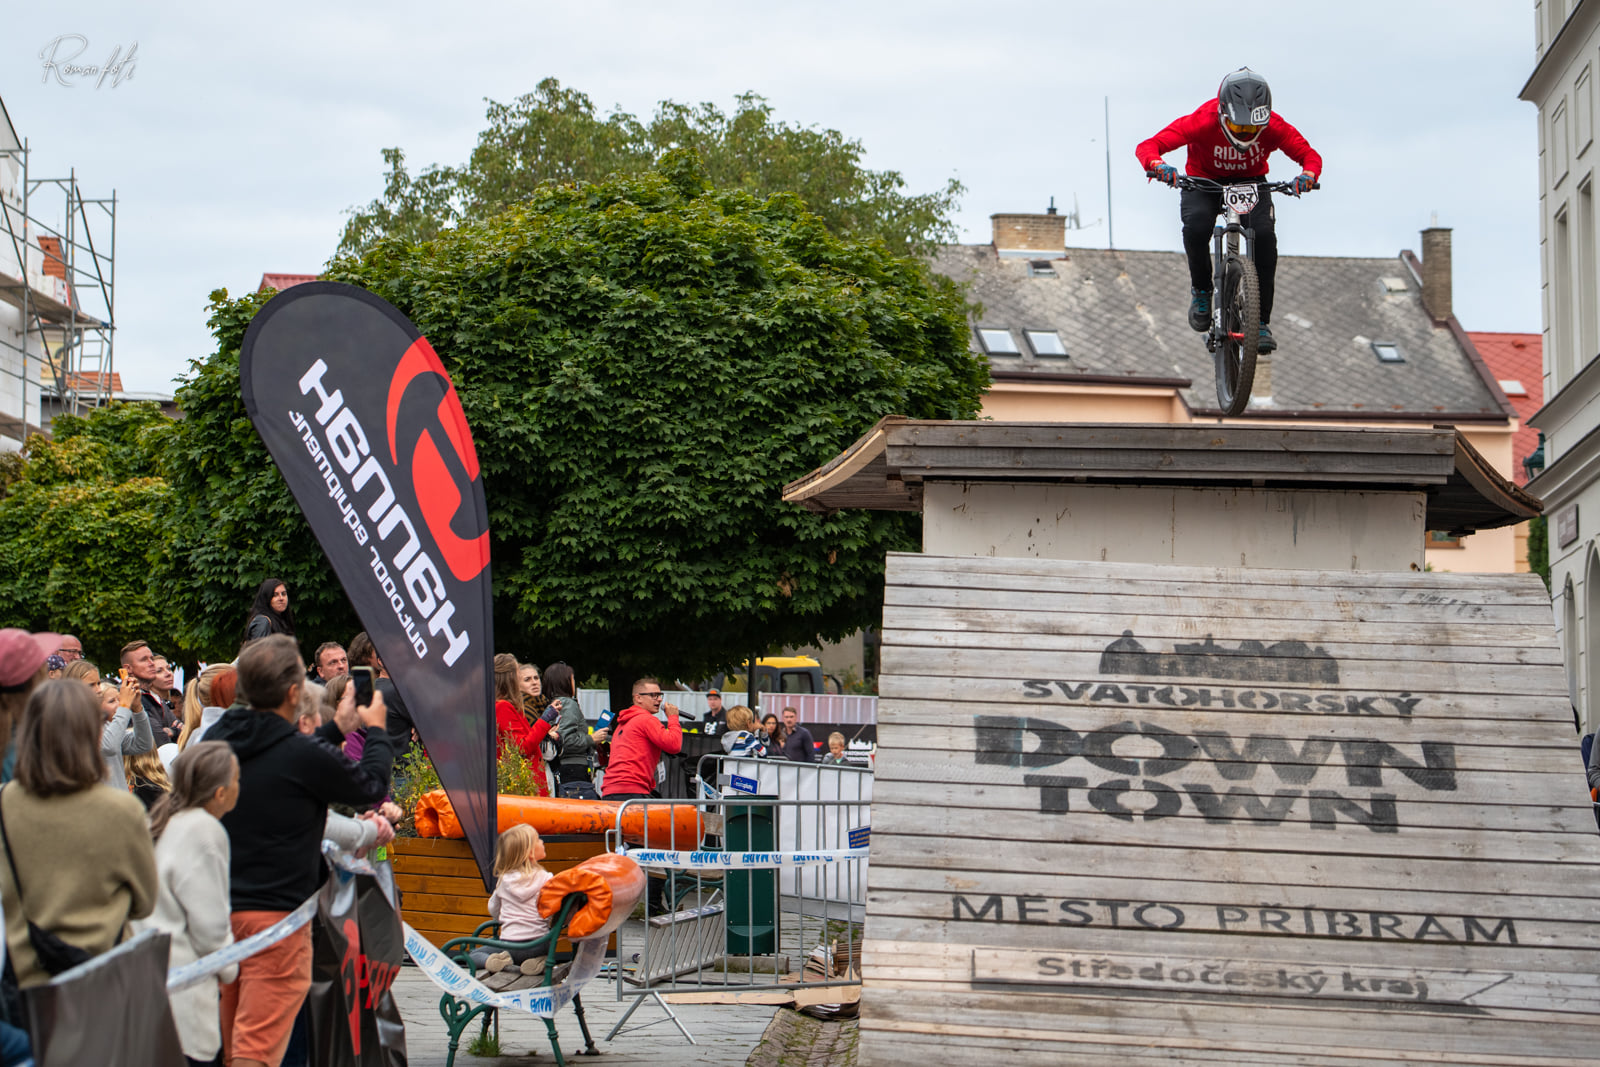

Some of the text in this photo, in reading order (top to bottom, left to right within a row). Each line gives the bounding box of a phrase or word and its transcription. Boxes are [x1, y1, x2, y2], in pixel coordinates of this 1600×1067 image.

[1214, 144, 1247, 160] RIDE
[1023, 679, 1422, 724] SVATOHORSKÝ
[973, 714, 1457, 791] DOWN
[1023, 774, 1398, 833] TOWN
[1037, 956, 1428, 1001] Středočeský kraj
